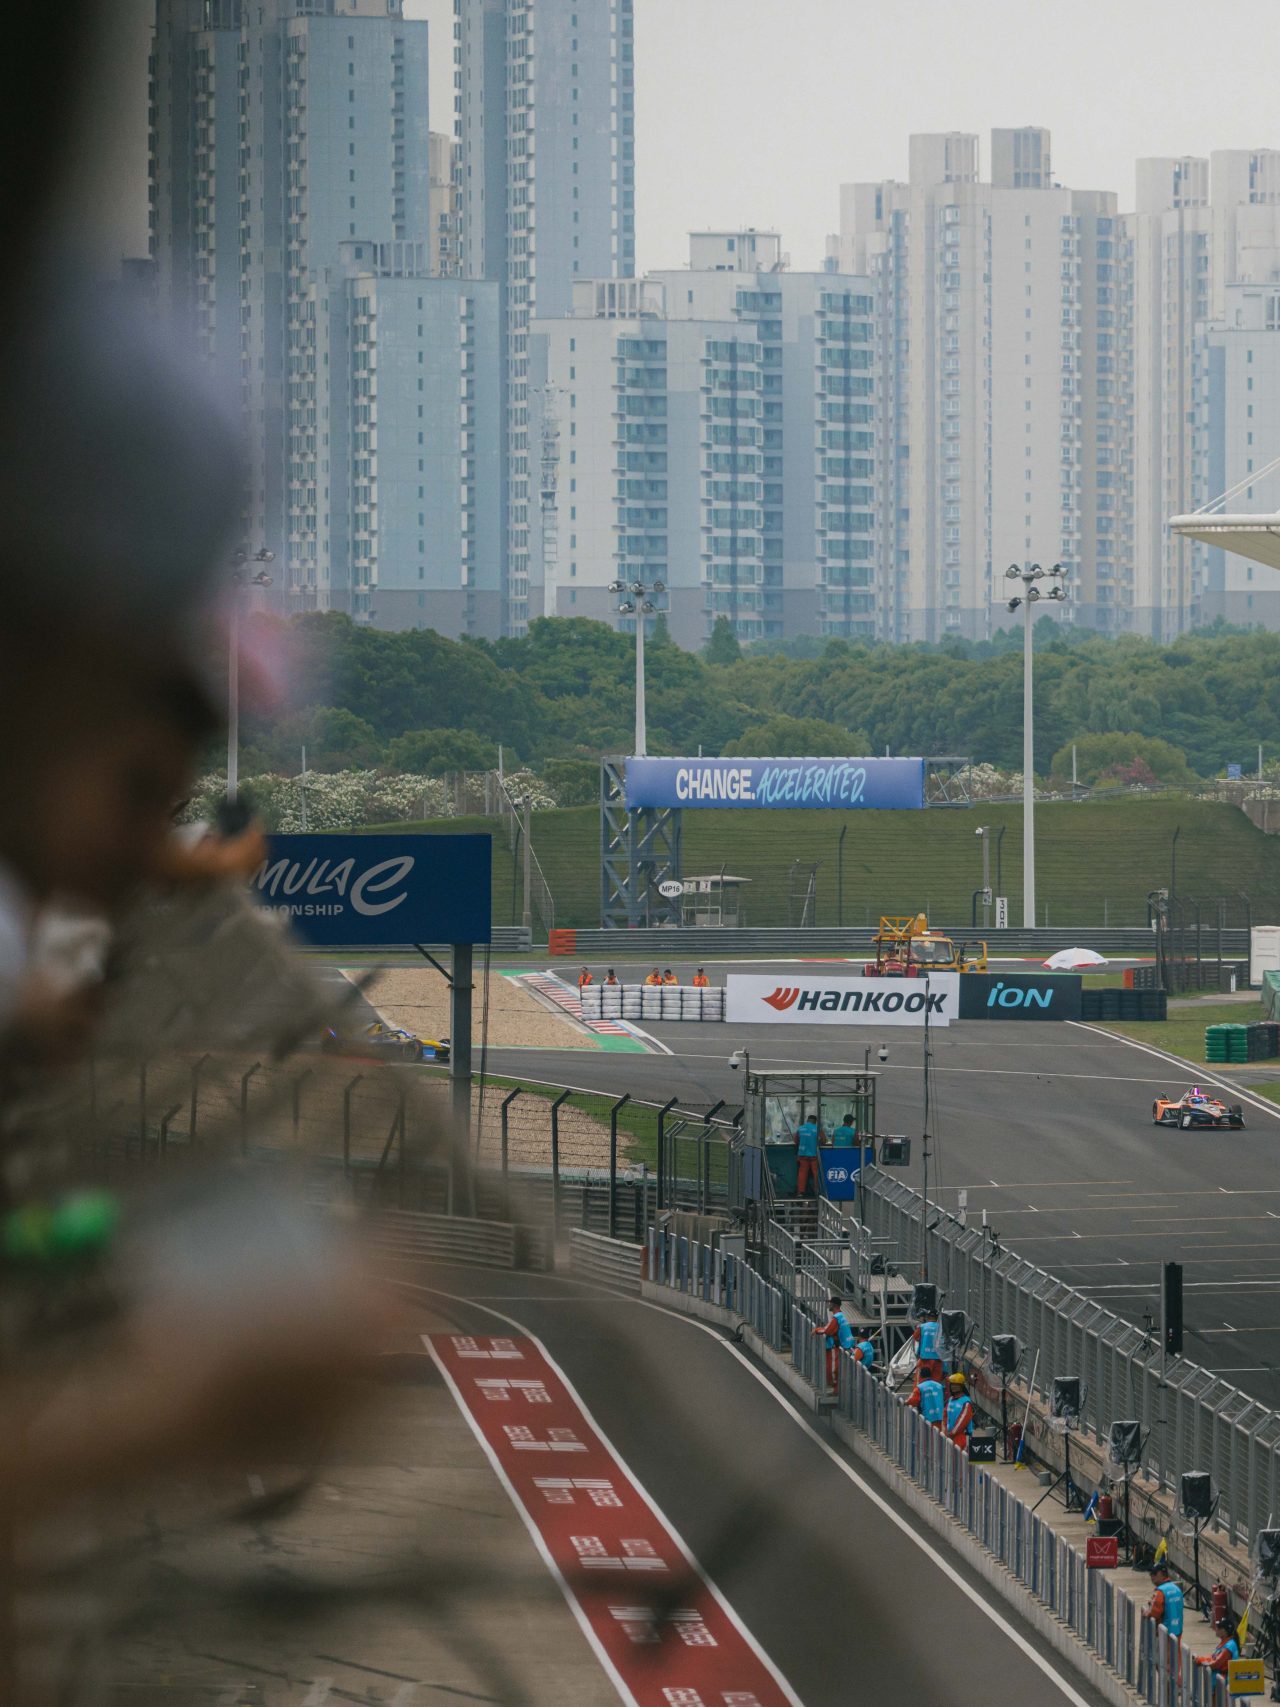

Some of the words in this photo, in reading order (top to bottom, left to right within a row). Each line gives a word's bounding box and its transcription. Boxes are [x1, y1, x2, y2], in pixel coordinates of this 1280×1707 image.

[675, 768, 755, 800] CHANGE.
[756, 763, 867, 805] ACCELERATED.
[249, 857, 356, 896] MULA
[661, 885, 681, 893] MP16
[253, 904, 344, 916] PIONSHIP
